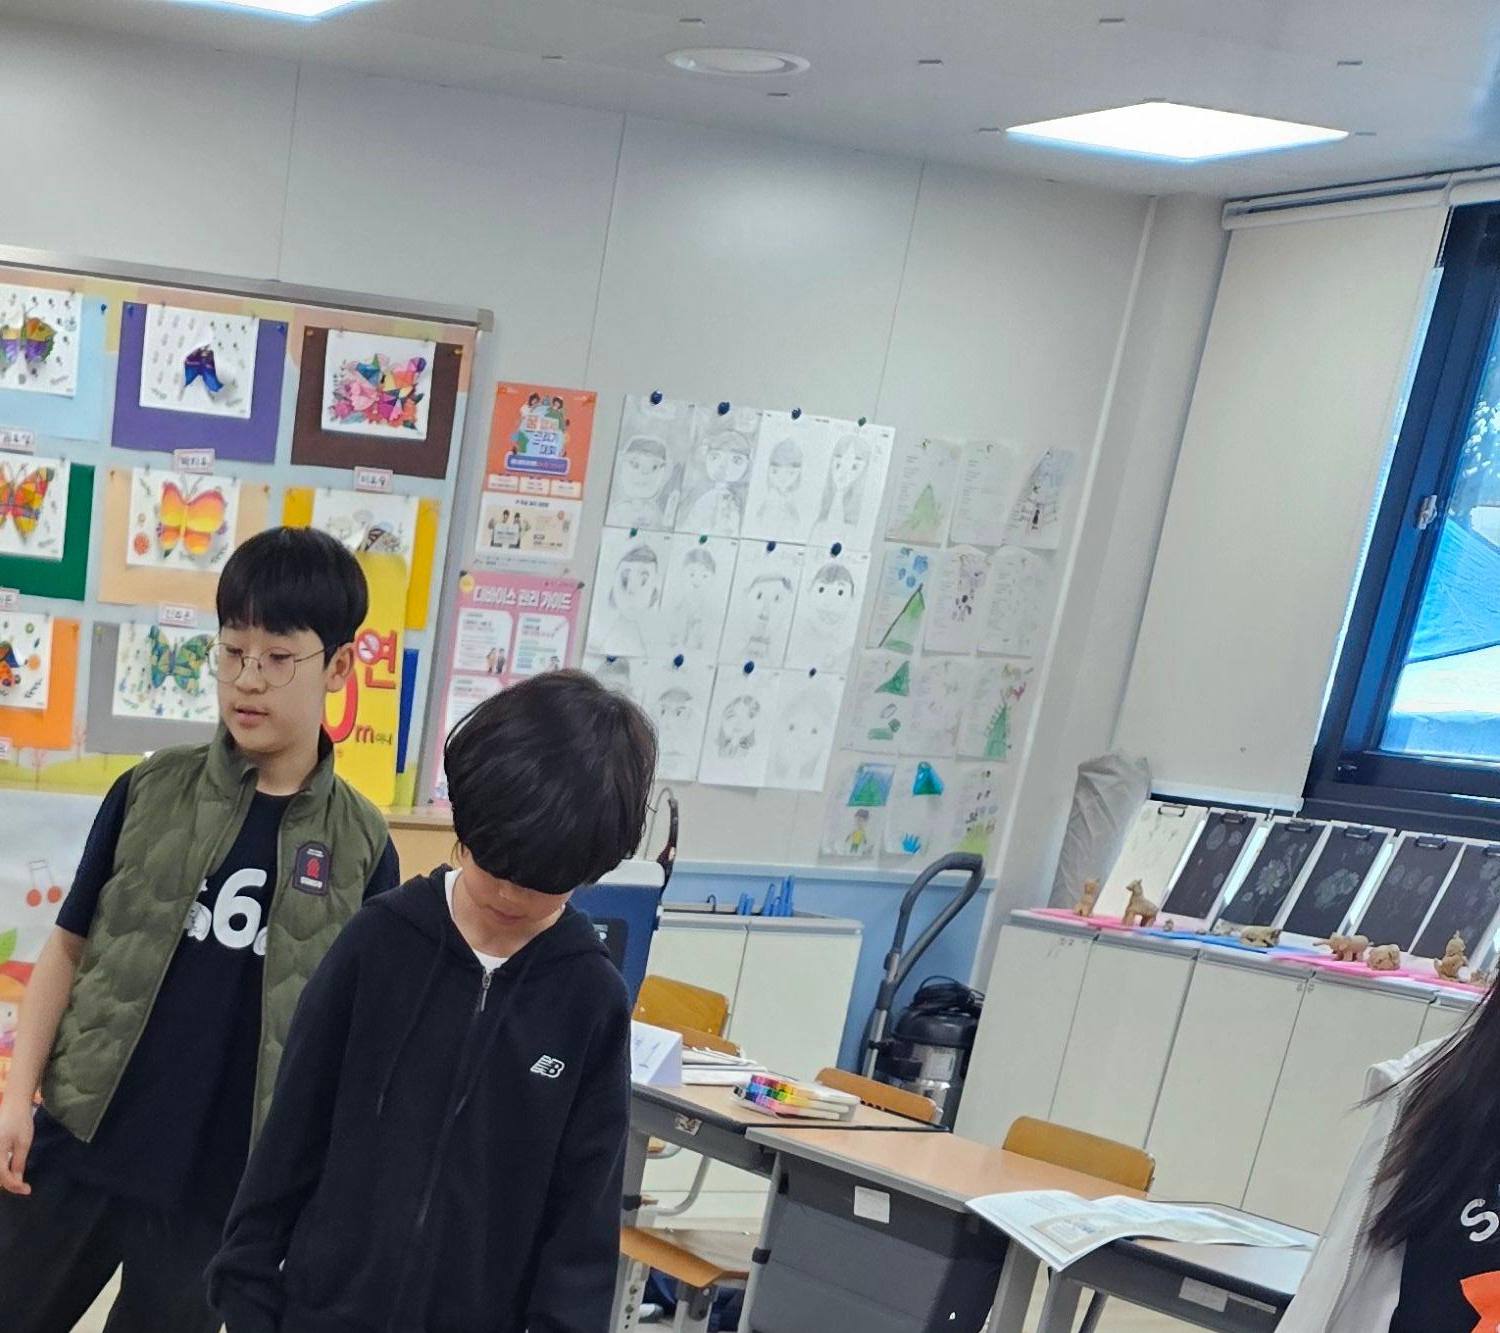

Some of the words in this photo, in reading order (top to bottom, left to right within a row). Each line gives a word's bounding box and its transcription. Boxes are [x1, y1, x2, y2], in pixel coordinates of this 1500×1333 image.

[473, 585, 516, 606] 디바이스
[518, 589, 539, 608] 관리
[541, 590, 572, 611] 가이드
